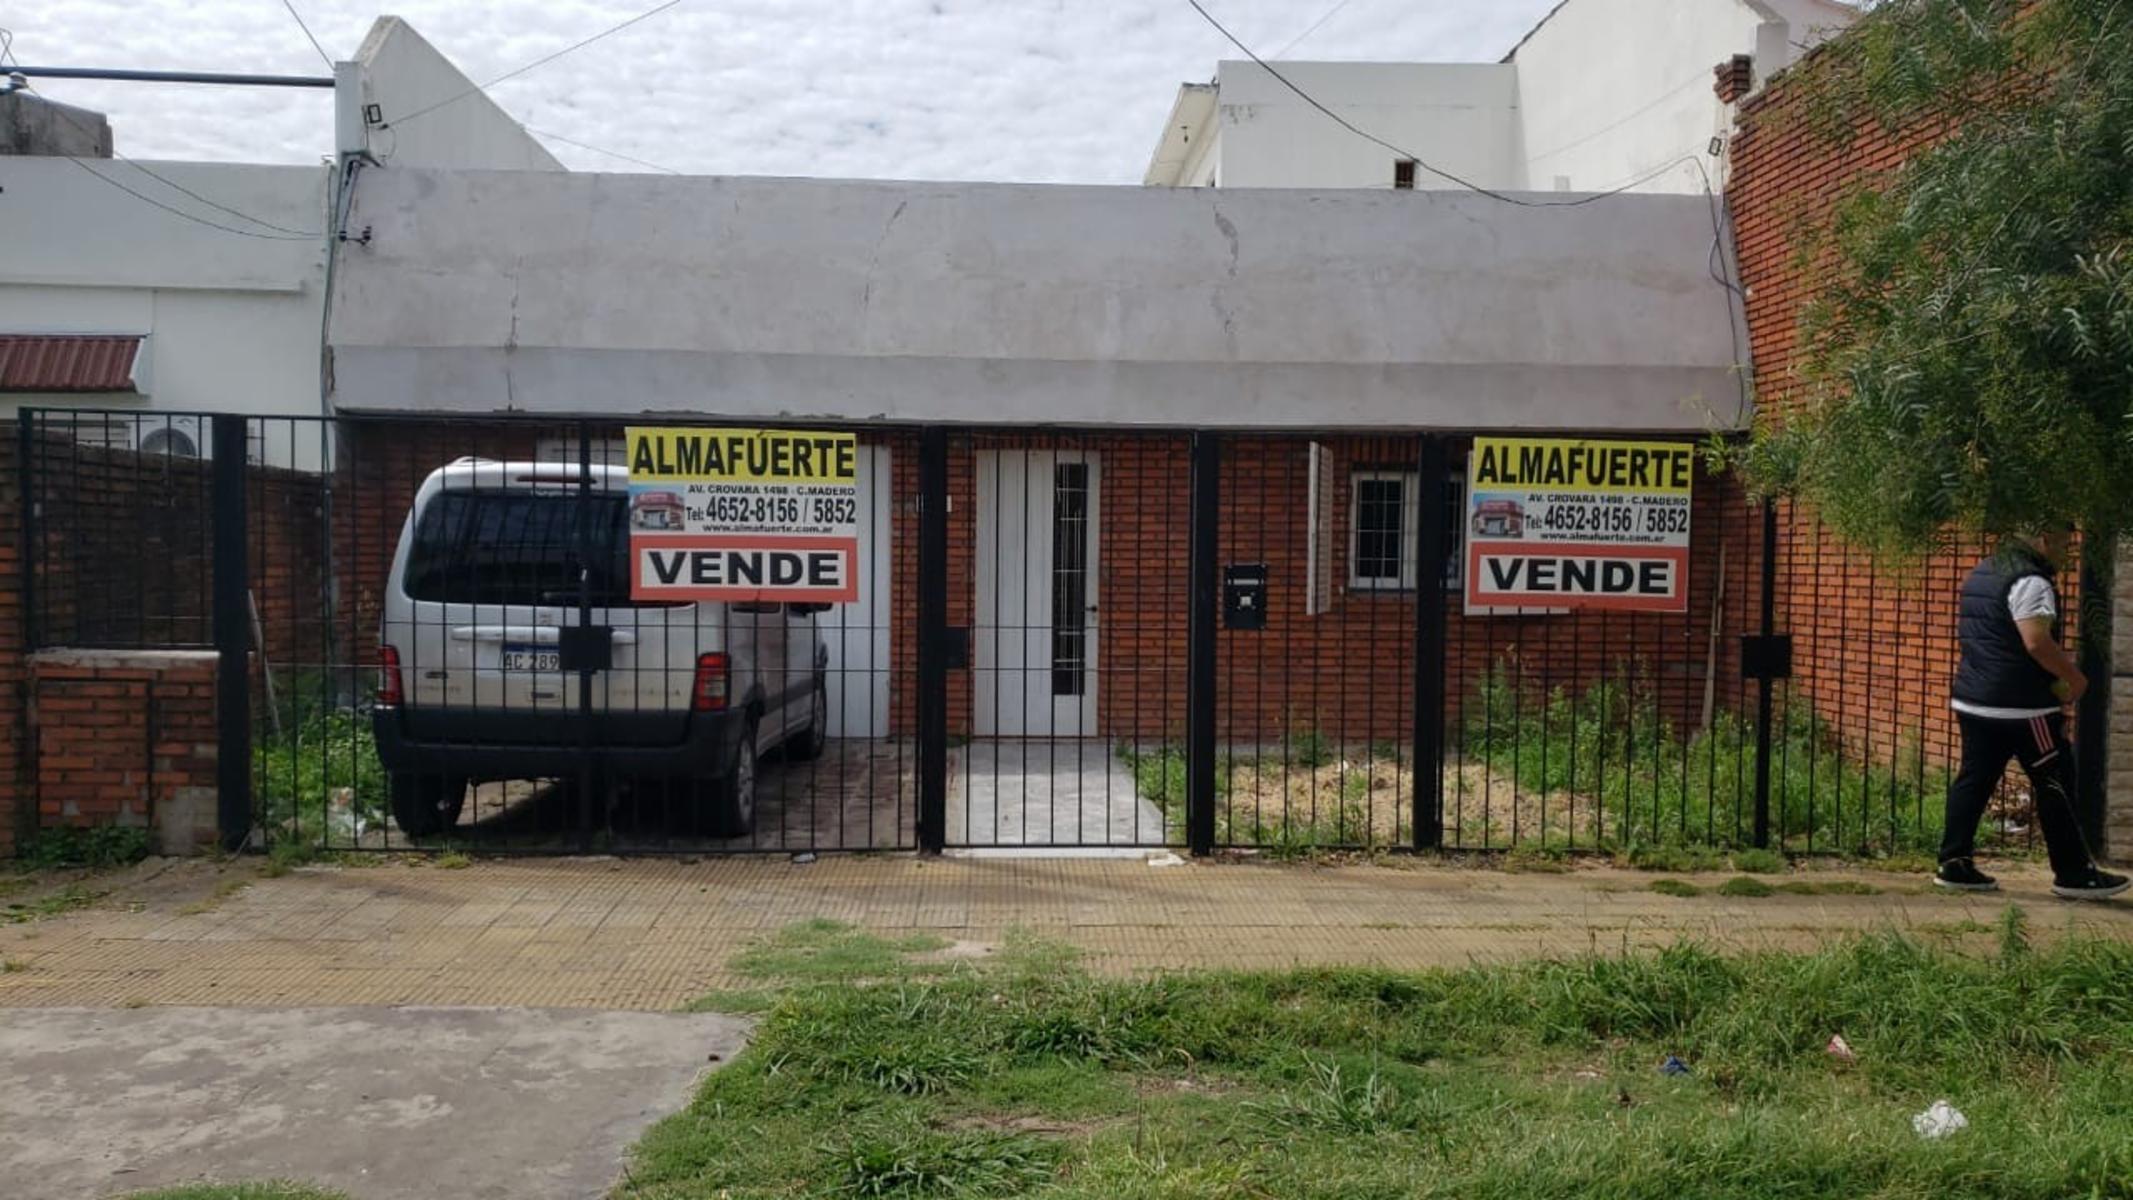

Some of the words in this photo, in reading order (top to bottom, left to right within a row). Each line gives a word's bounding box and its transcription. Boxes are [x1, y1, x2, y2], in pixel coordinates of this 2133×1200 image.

[632, 436, 855, 478] ALMAFUERTE
[1476, 445, 1689, 488] ALMAFUERTE
[688, 485, 706, 494] AV.
[708, 485, 760, 495] CROVARA
[796, 486, 856, 496] C.MADERO
[1547, 494, 1596, 504] CROVARA
[686, 507, 705, 521] Tel:
[706, 496, 798, 523] 4652-8156
[802, 499, 809, 523] /
[813, 498, 856, 524] 5852
[1525, 515, 1543, 530] Tel:
[1544, 505, 1632, 532] 4652-8156
[1636, 507, 1643, 532] /
[1646, 508, 1688, 533] 5852
[702, 524, 833, 534] www.almafuerte.com.ar
[1540, 532, 1666, 543] www.almafuerte.com.ar
[648, 551, 840, 586] VENDE
[1487, 558, 1670, 594] VENDE
